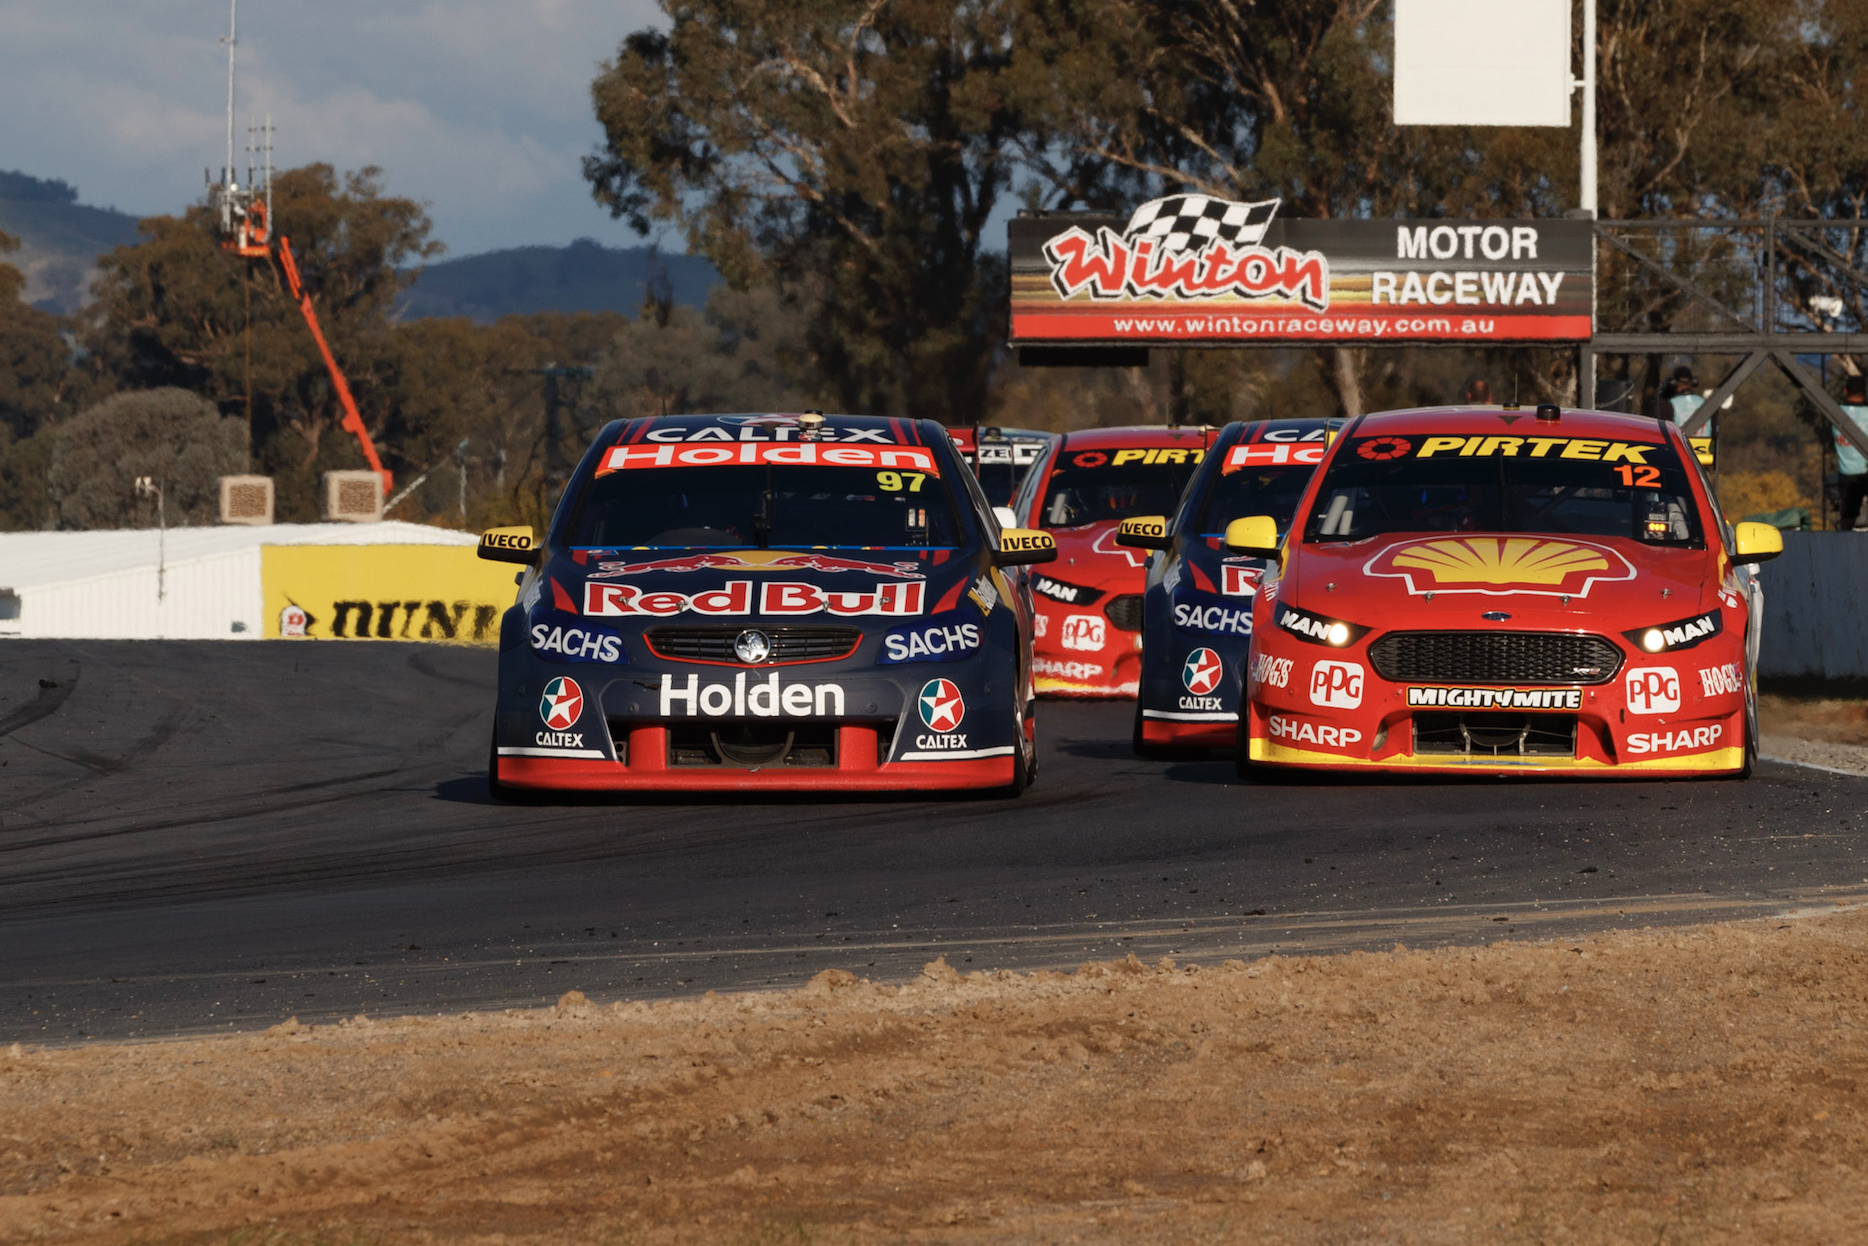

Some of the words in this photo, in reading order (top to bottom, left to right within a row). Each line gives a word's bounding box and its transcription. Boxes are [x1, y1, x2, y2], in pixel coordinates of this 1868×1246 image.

[1398, 226, 1538, 260] MOTOR
[1042, 226, 1328, 313] Winton
[1372, 271, 1565, 306] RACEWAY
[1113, 316, 1495, 337] www.wintonraceway.com.au
[645, 427, 895, 443] CALTEX
[608, 442, 933, 468] Holden
[1112, 448, 1207, 466] PIRT
[1416, 436, 1657, 465] PIRTEK
[876, 471, 926, 492] 97
[1613, 465, 1663, 489] 12
[481, 533, 532, 549] IVECO
[1002, 536, 1053, 551] IVECO
[1120, 523, 1163, 536] IVECO
[583, 581, 752, 616] Red
[760, 581, 926, 616] Bull
[1035, 578, 1078, 602] MAN
[1174, 604, 1253, 635] SACHS
[1280, 610, 1331, 640] MAN
[1663, 616, 1716, 646] MAN
[530, 624, 623, 663] SACHS
[885, 624, 980, 662] SACHS
[659, 672, 845, 717] Holden
[1312, 665, 1362, 702] PPG
[1627, 672, 1680, 711] PPG
[1179, 696, 1222, 710] CALTEX
[535, 732, 584, 749] CALTEX
[916, 733, 967, 751] CALTEX
[1268, 715, 1362, 748] SHARP
[1626, 723, 1723, 754] SHARP
